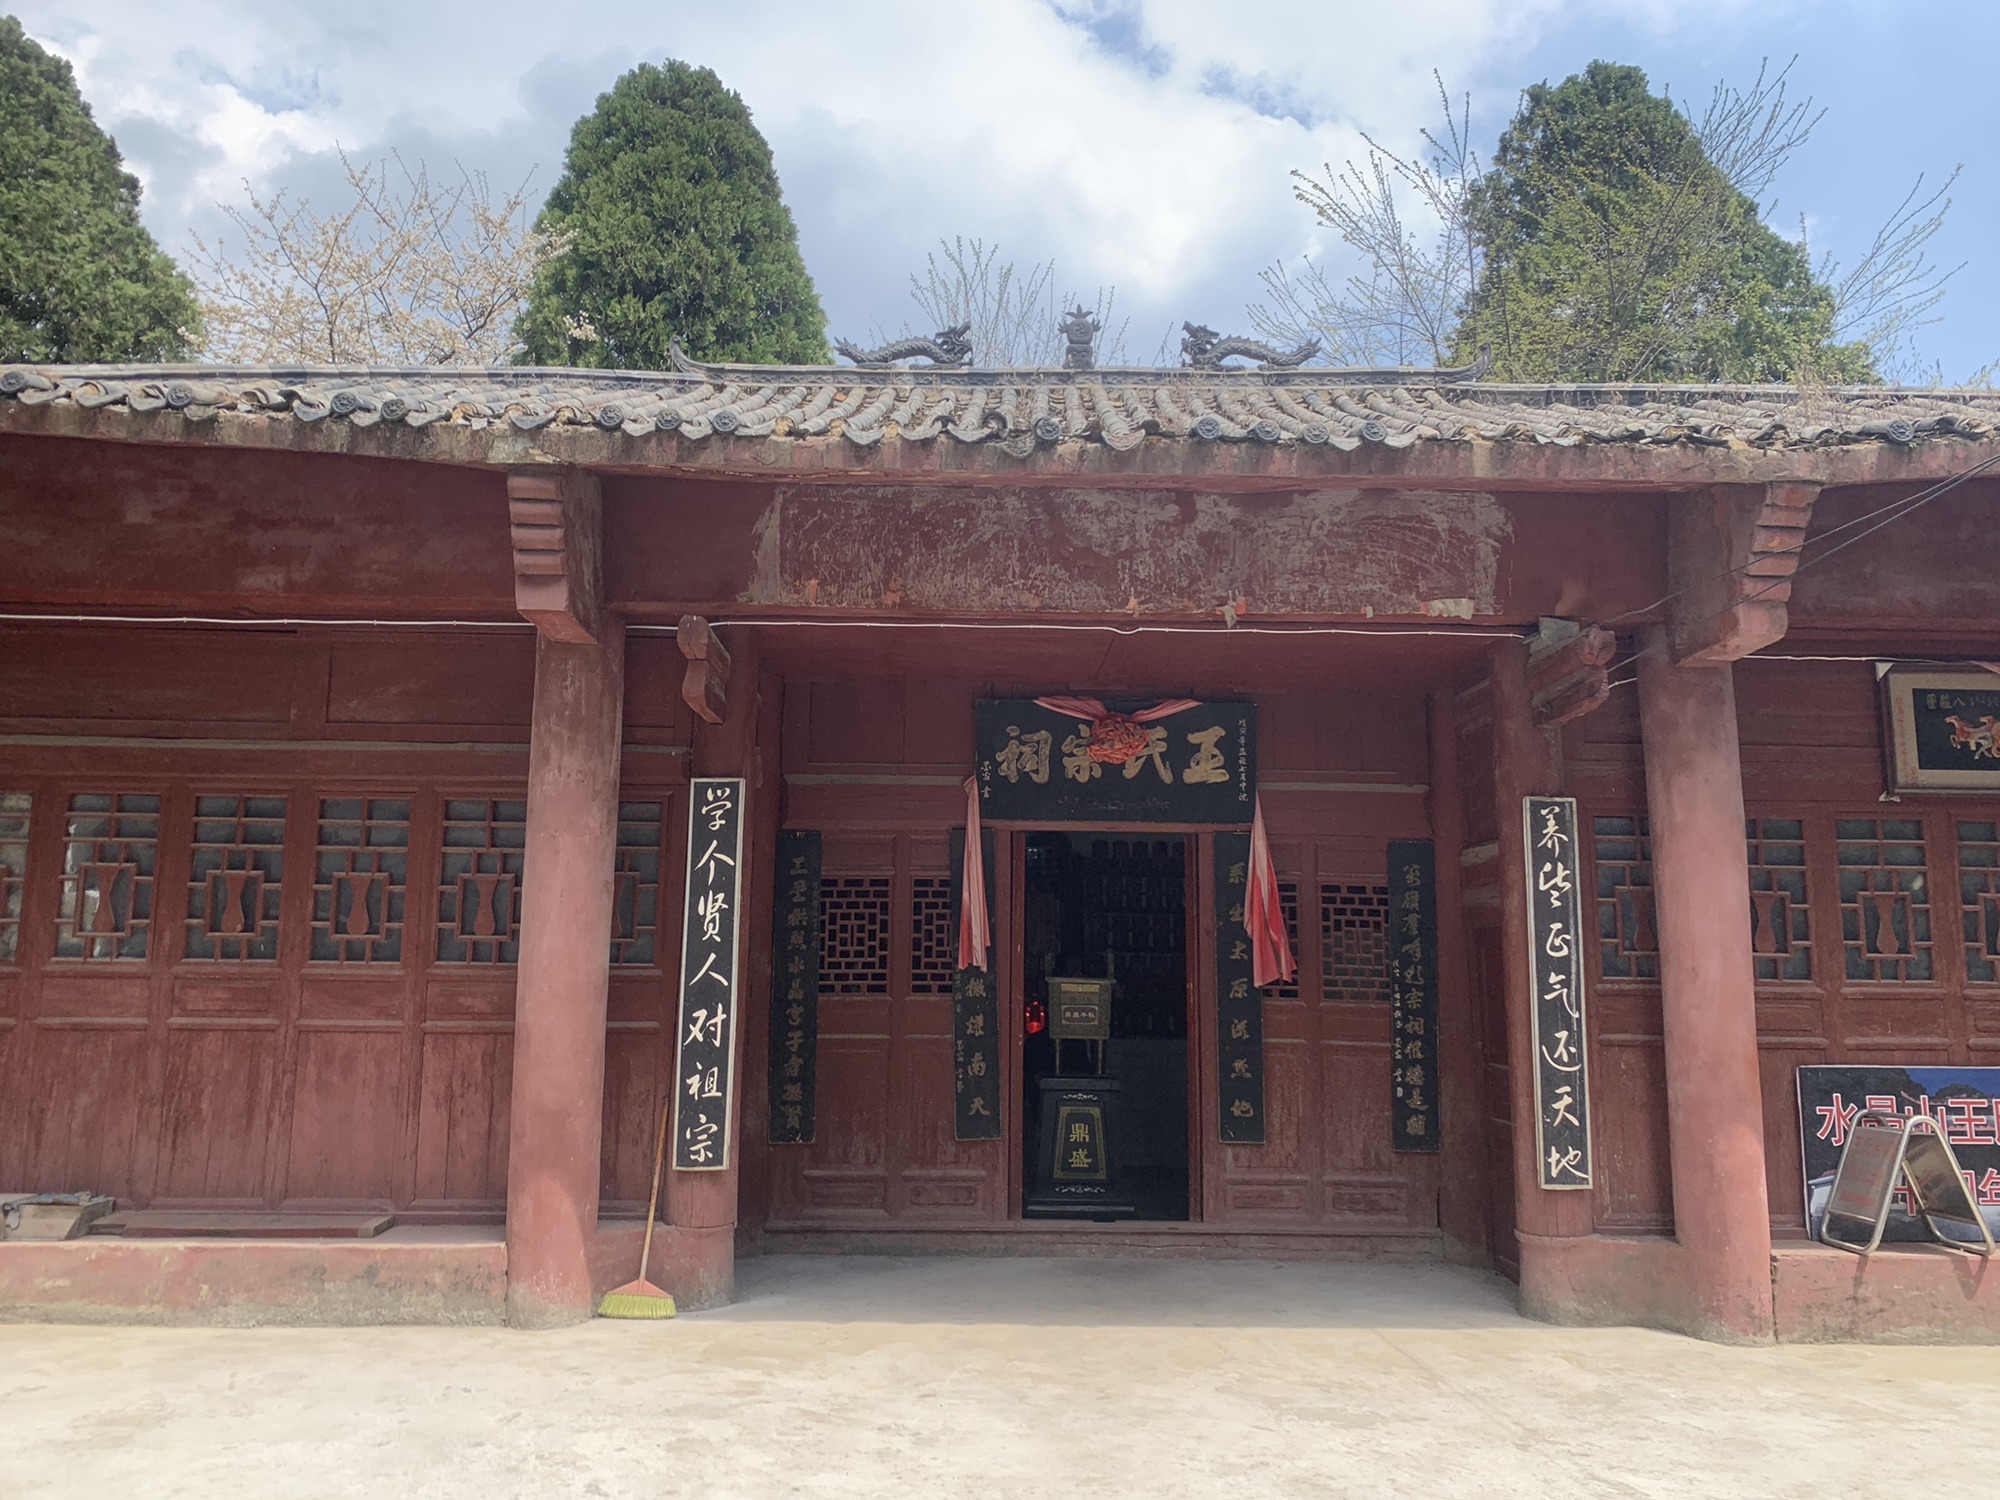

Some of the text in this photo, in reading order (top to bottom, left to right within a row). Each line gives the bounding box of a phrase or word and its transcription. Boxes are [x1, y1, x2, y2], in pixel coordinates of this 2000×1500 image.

[683, 787, 735, 1163] 学个贤人对祖宗
[1068, 1123, 1092, 1168] 鼎盛
[1537, 806, 1590, 1178] 养些正气还天地
